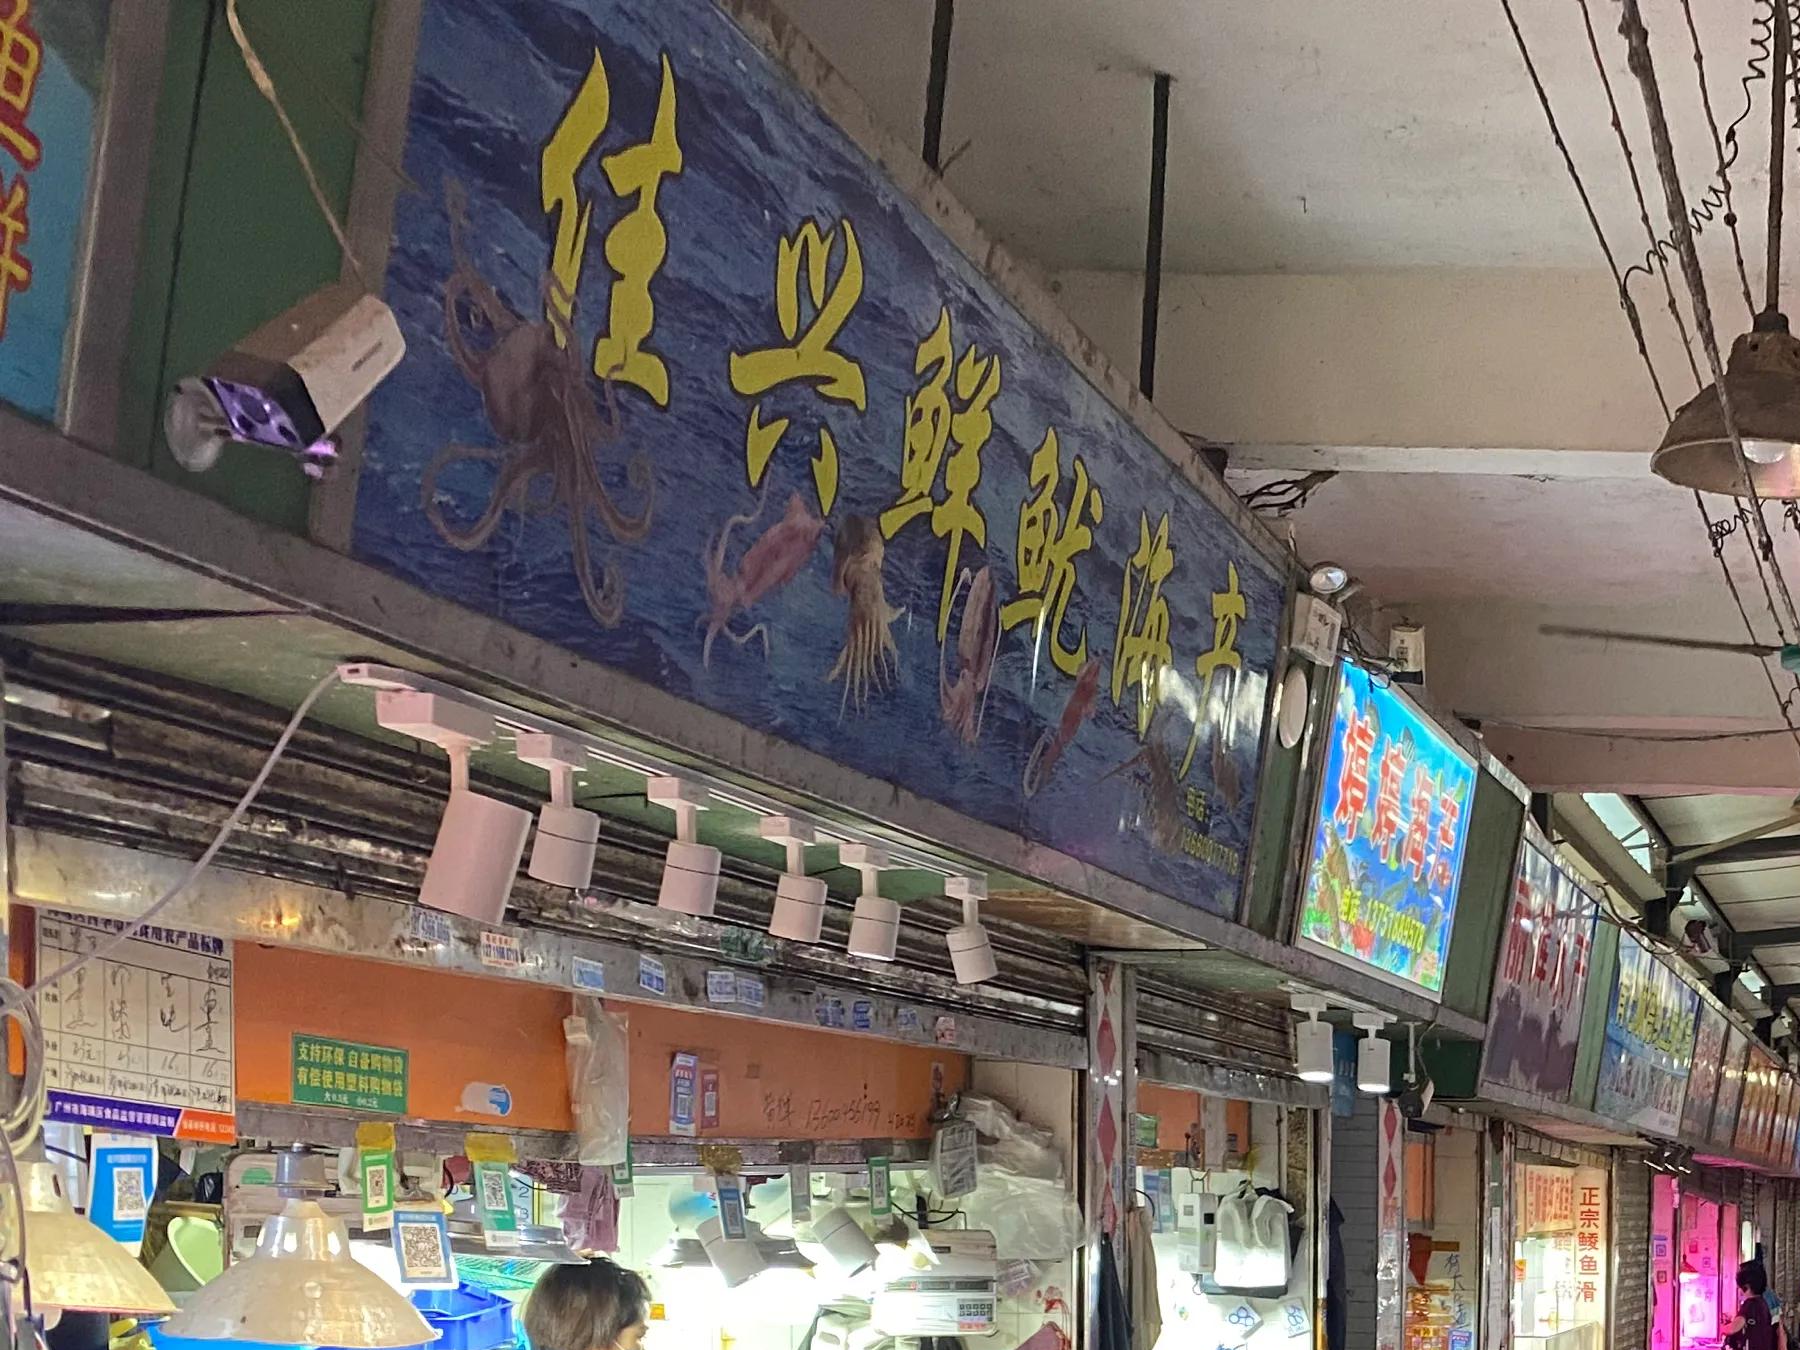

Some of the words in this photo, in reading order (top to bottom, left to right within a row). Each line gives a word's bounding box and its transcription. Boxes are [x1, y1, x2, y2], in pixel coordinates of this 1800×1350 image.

[1577, 1186, 1600, 1304] 正宗鲮鱼滑
